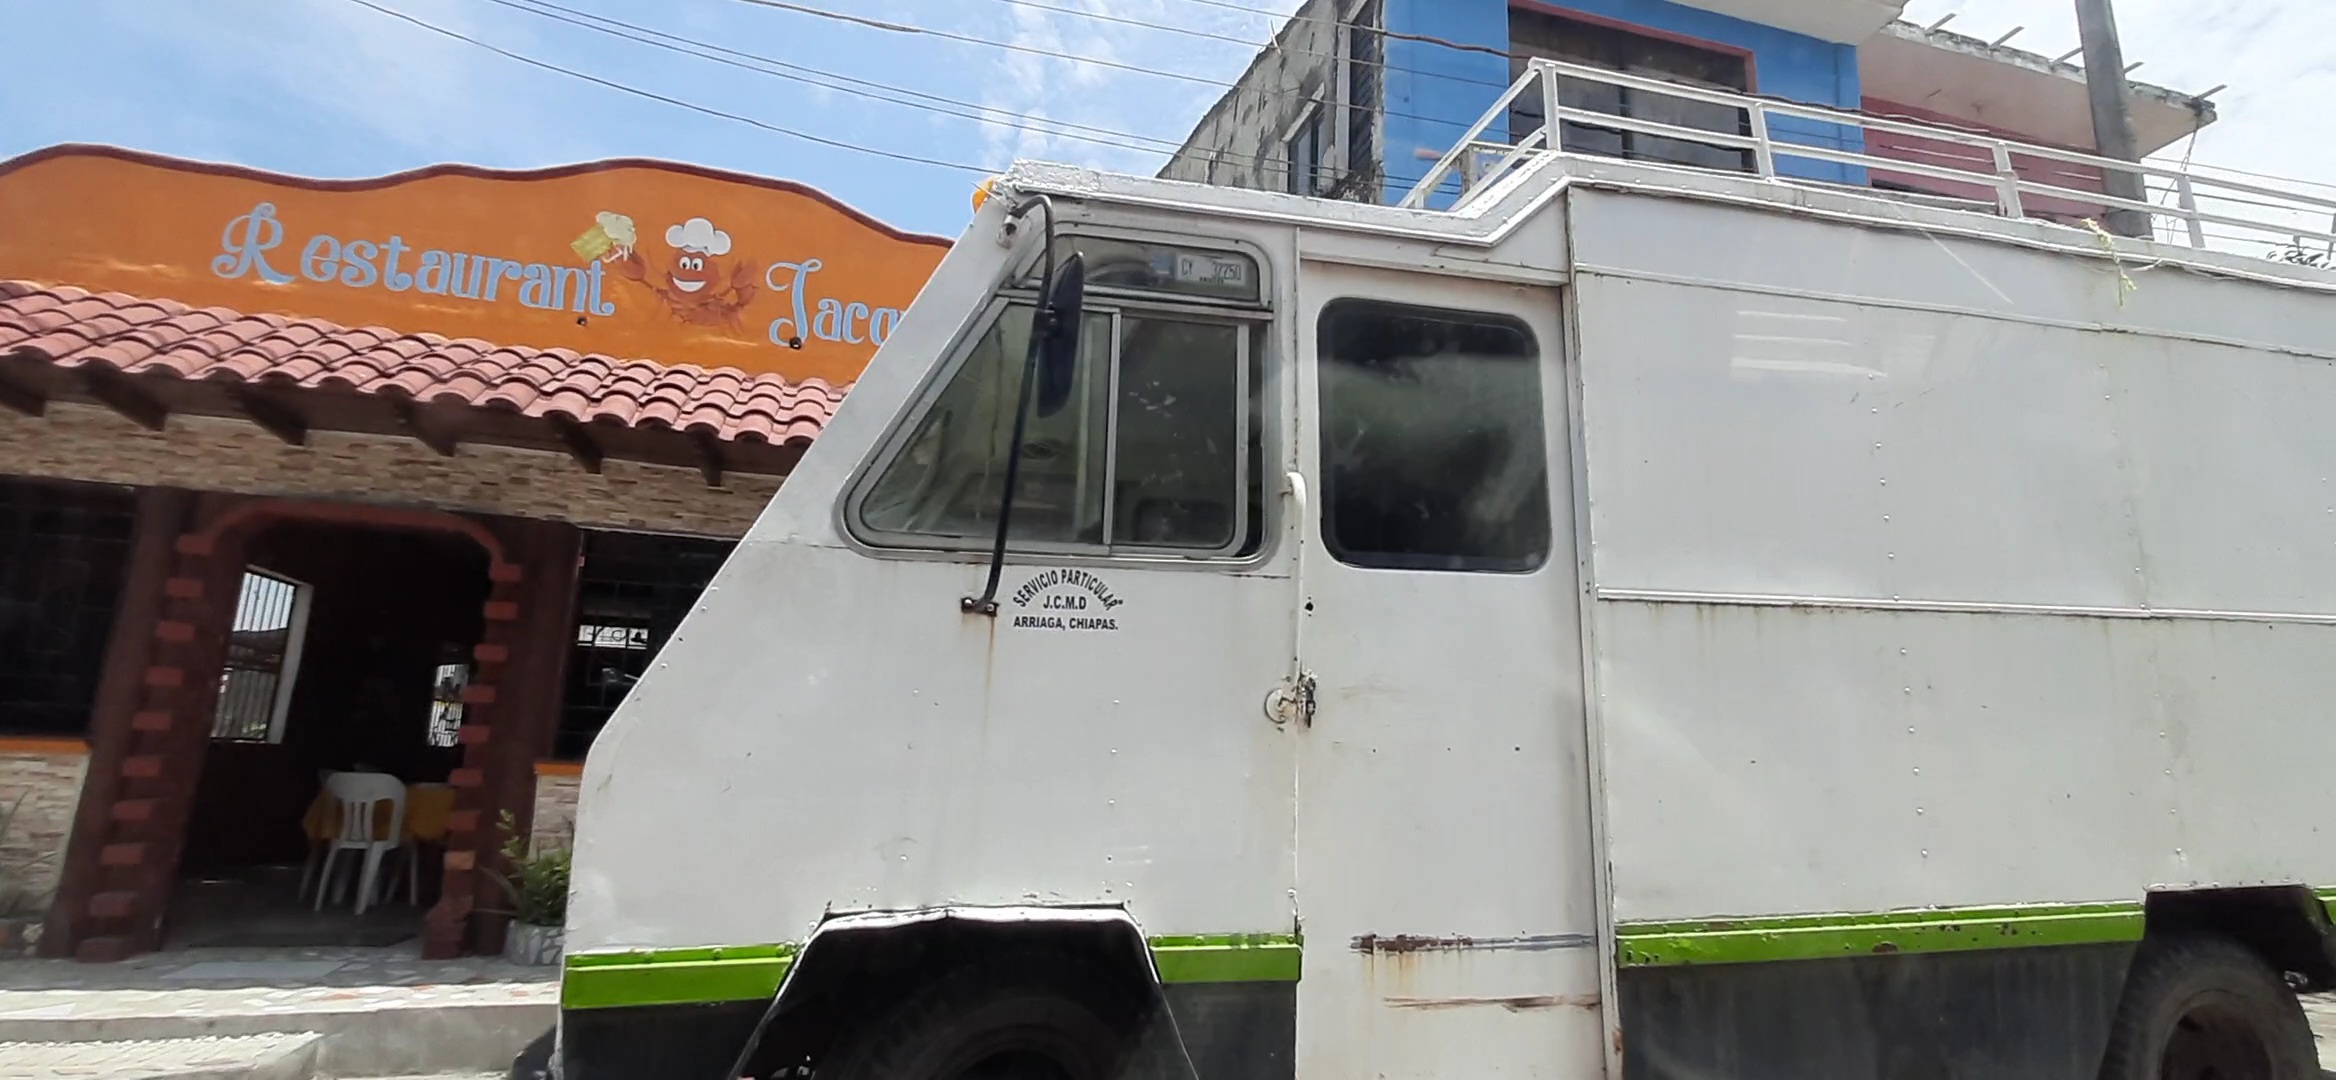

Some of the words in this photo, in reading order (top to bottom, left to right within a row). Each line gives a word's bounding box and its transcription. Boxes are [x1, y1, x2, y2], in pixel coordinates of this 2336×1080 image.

[211, 202, 615, 317] Restaurant
[1013, 569, 1058, 607] SERVICIO
[1043, 595, 1087, 610] J.C.M.D
[1013, 616, 1066, 631] ARRIAGA,
[1069, 617, 1119, 630] CHIAPAS.
